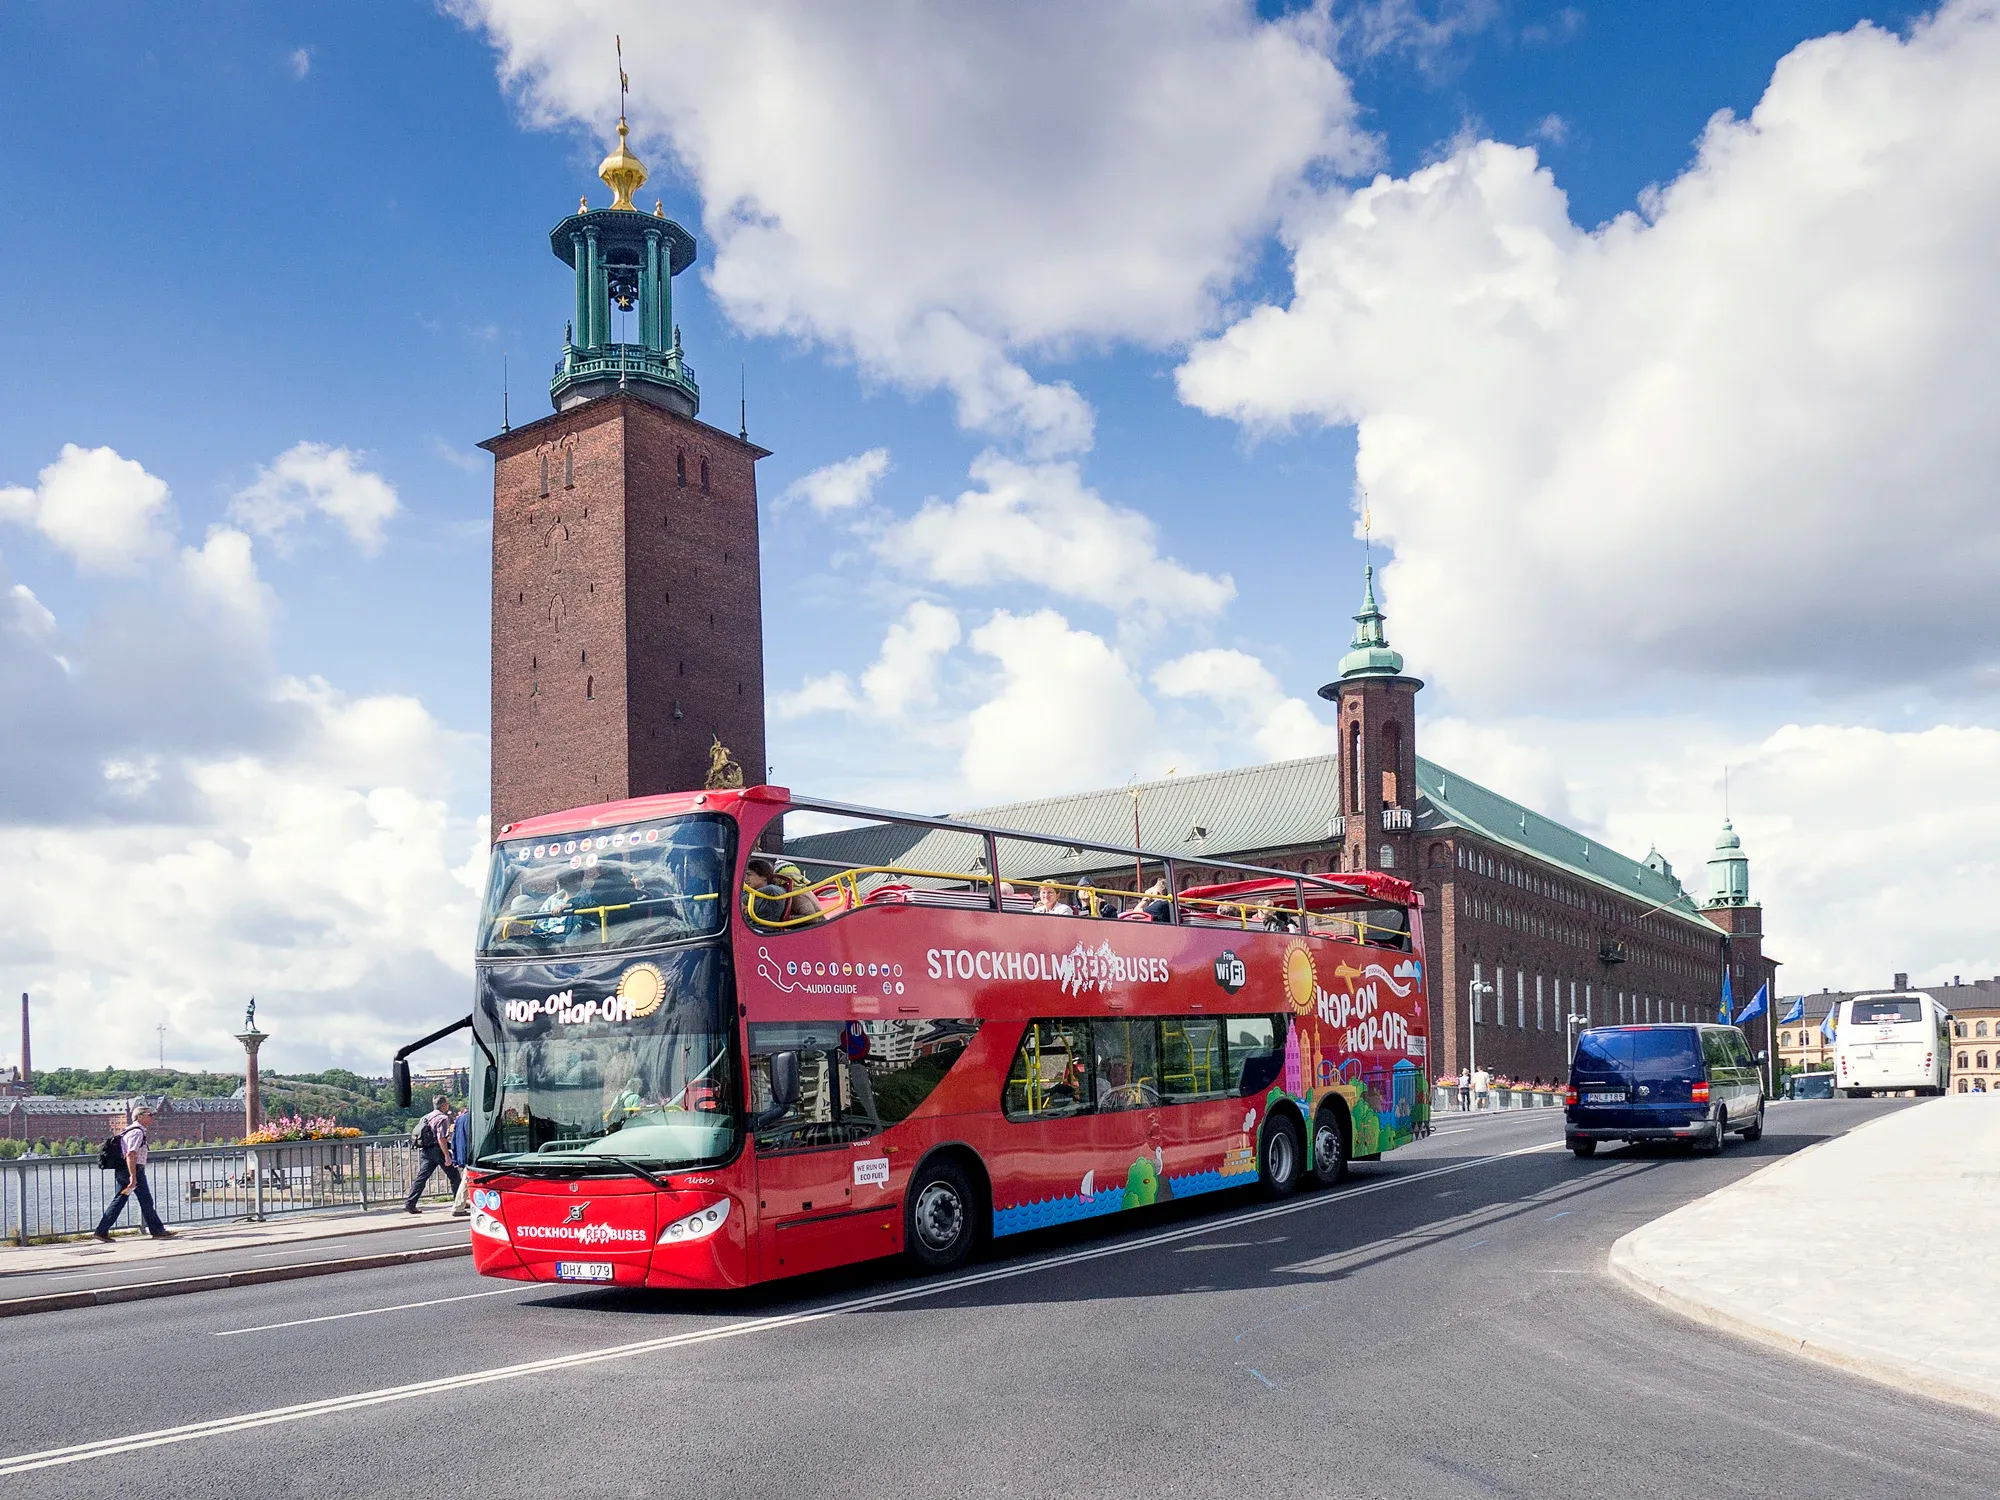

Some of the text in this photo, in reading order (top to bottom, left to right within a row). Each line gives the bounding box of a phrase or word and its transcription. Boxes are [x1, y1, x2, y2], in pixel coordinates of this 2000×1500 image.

[1223, 951, 1235, 961] Free
[927, 949, 1067, 981] STOCKHOLM
[1115, 957, 1169, 982] BUSES
[806, 984, 857, 994] AUDIO GUIDE
[505, 989, 573, 1022] HOP-ON
[558, 996, 636, 1024] HOP-OFF
[1316, 981, 1378, 1029] HOP-ON
[1346, 1010, 1408, 1053] HOP-OFF
[856, 1164, 865, 1172] WE
[878, 1162, 887, 1170] ON
[860, 1172, 884, 1181] ECO FUEL
[516, 1226, 581, 1239] STOCKHOLM
[612, 1229, 647, 1241] BUSES
[562, 1263, 610, 1276] DHX 079
